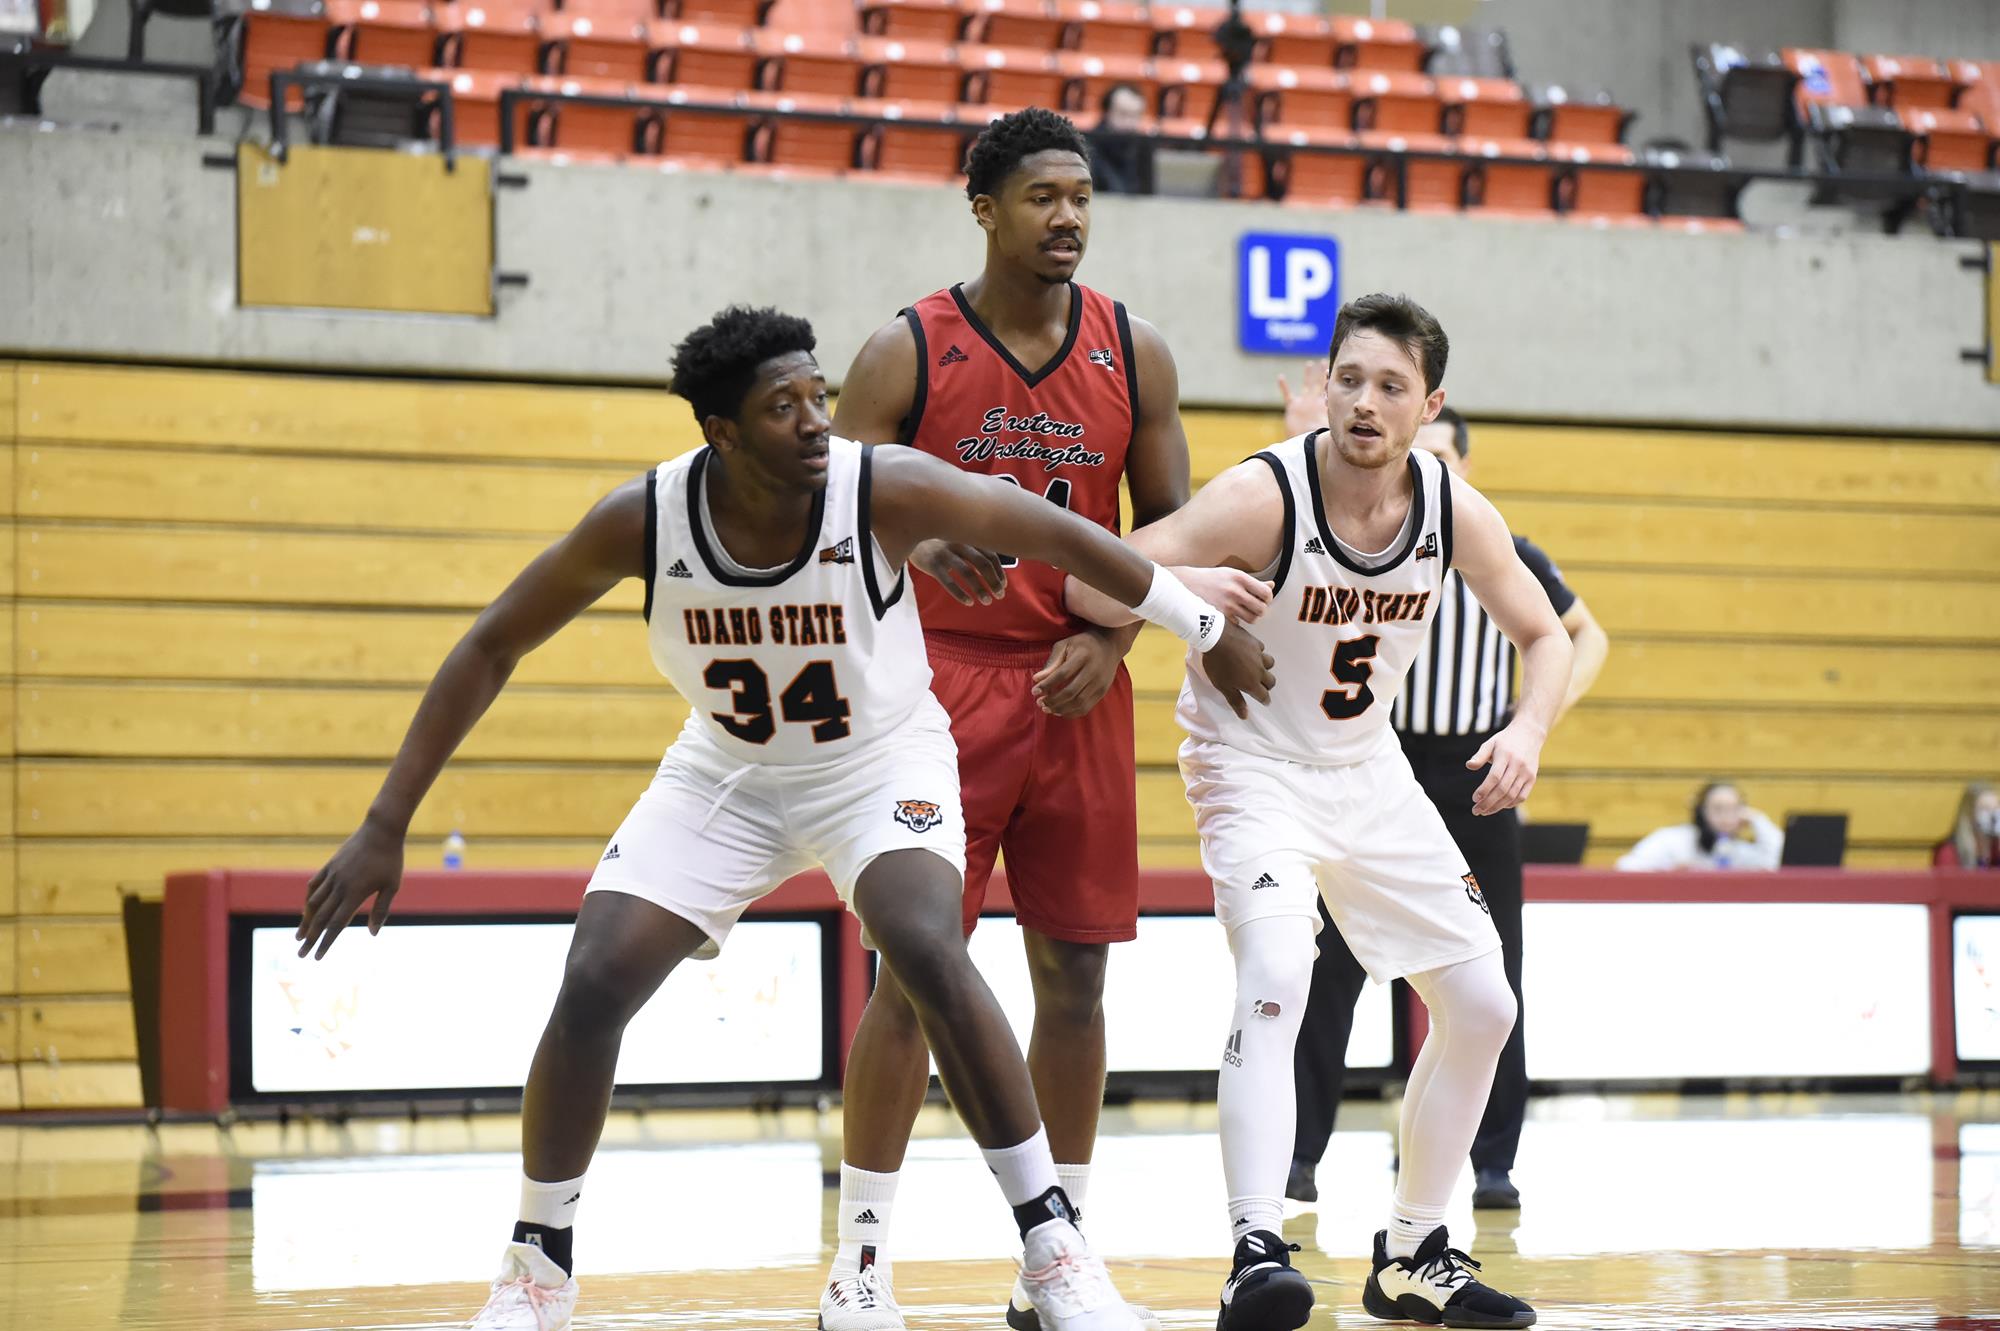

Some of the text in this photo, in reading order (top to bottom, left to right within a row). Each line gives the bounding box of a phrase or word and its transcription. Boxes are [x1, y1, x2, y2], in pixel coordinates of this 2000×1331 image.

[1248, 245, 1333, 320] LP
[980, 406, 1083, 438] Eastern
[956, 437, 1105, 471] Washington
[683, 603, 848, 646] IDAHO STATE
[1363, 589, 1431, 625] STATE
[1319, 633, 1381, 721] 5
[702, 658, 852, 745] 34
[1251, 880, 1280, 891] adidas
[854, 1216, 880, 1225] adidas
